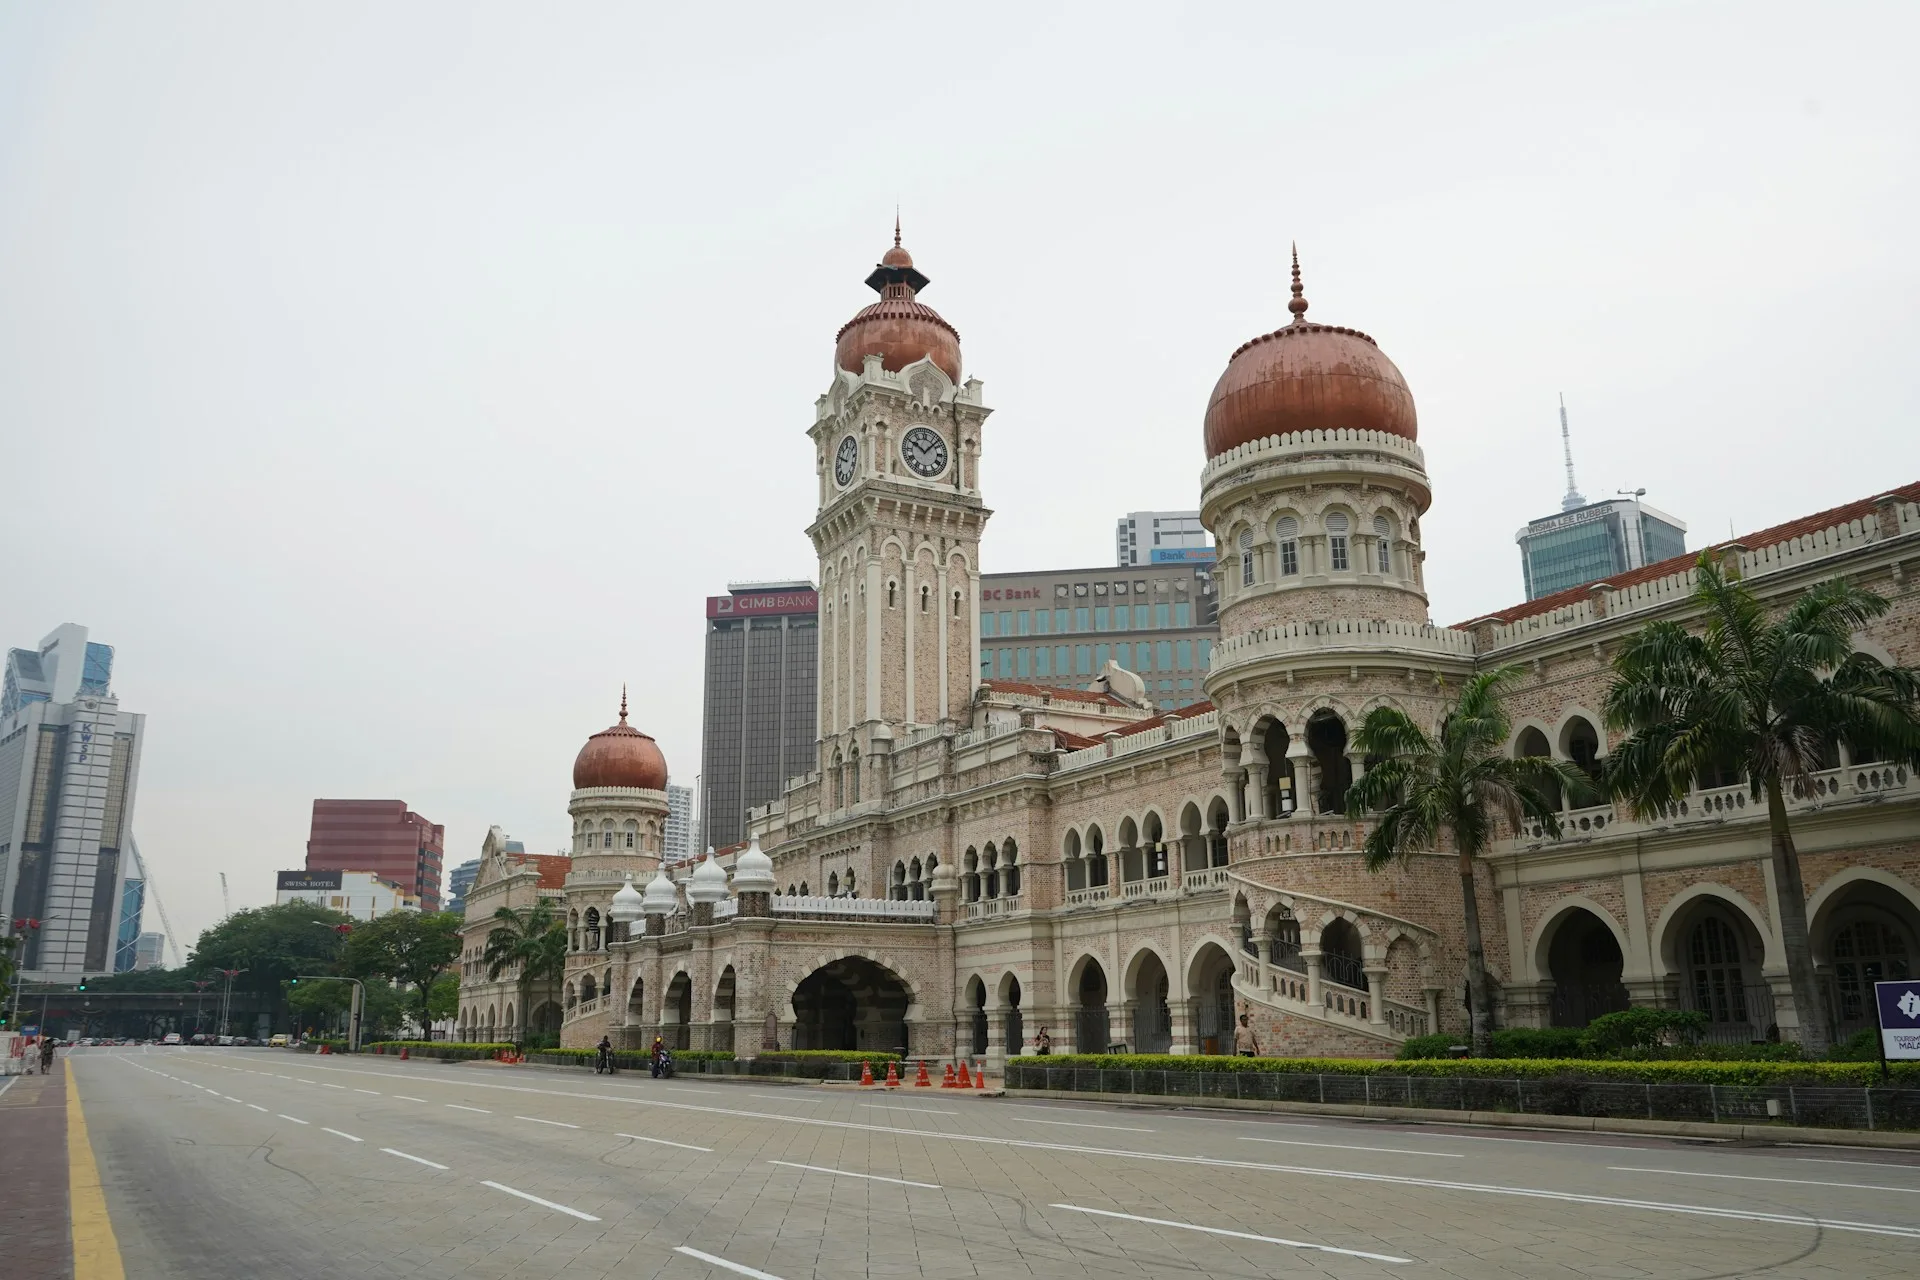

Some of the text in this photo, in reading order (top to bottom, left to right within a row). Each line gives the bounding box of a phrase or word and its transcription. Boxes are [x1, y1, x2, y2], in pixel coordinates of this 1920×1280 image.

[1528, 505, 1613, 534] WISMA LEE RUBBER
[1160, 551, 1185, 560] Bank
[1005, 587, 1040, 600] Bank
[739, 595, 813, 609] CIMB BANK
[79, 723, 92, 763] KWSP
